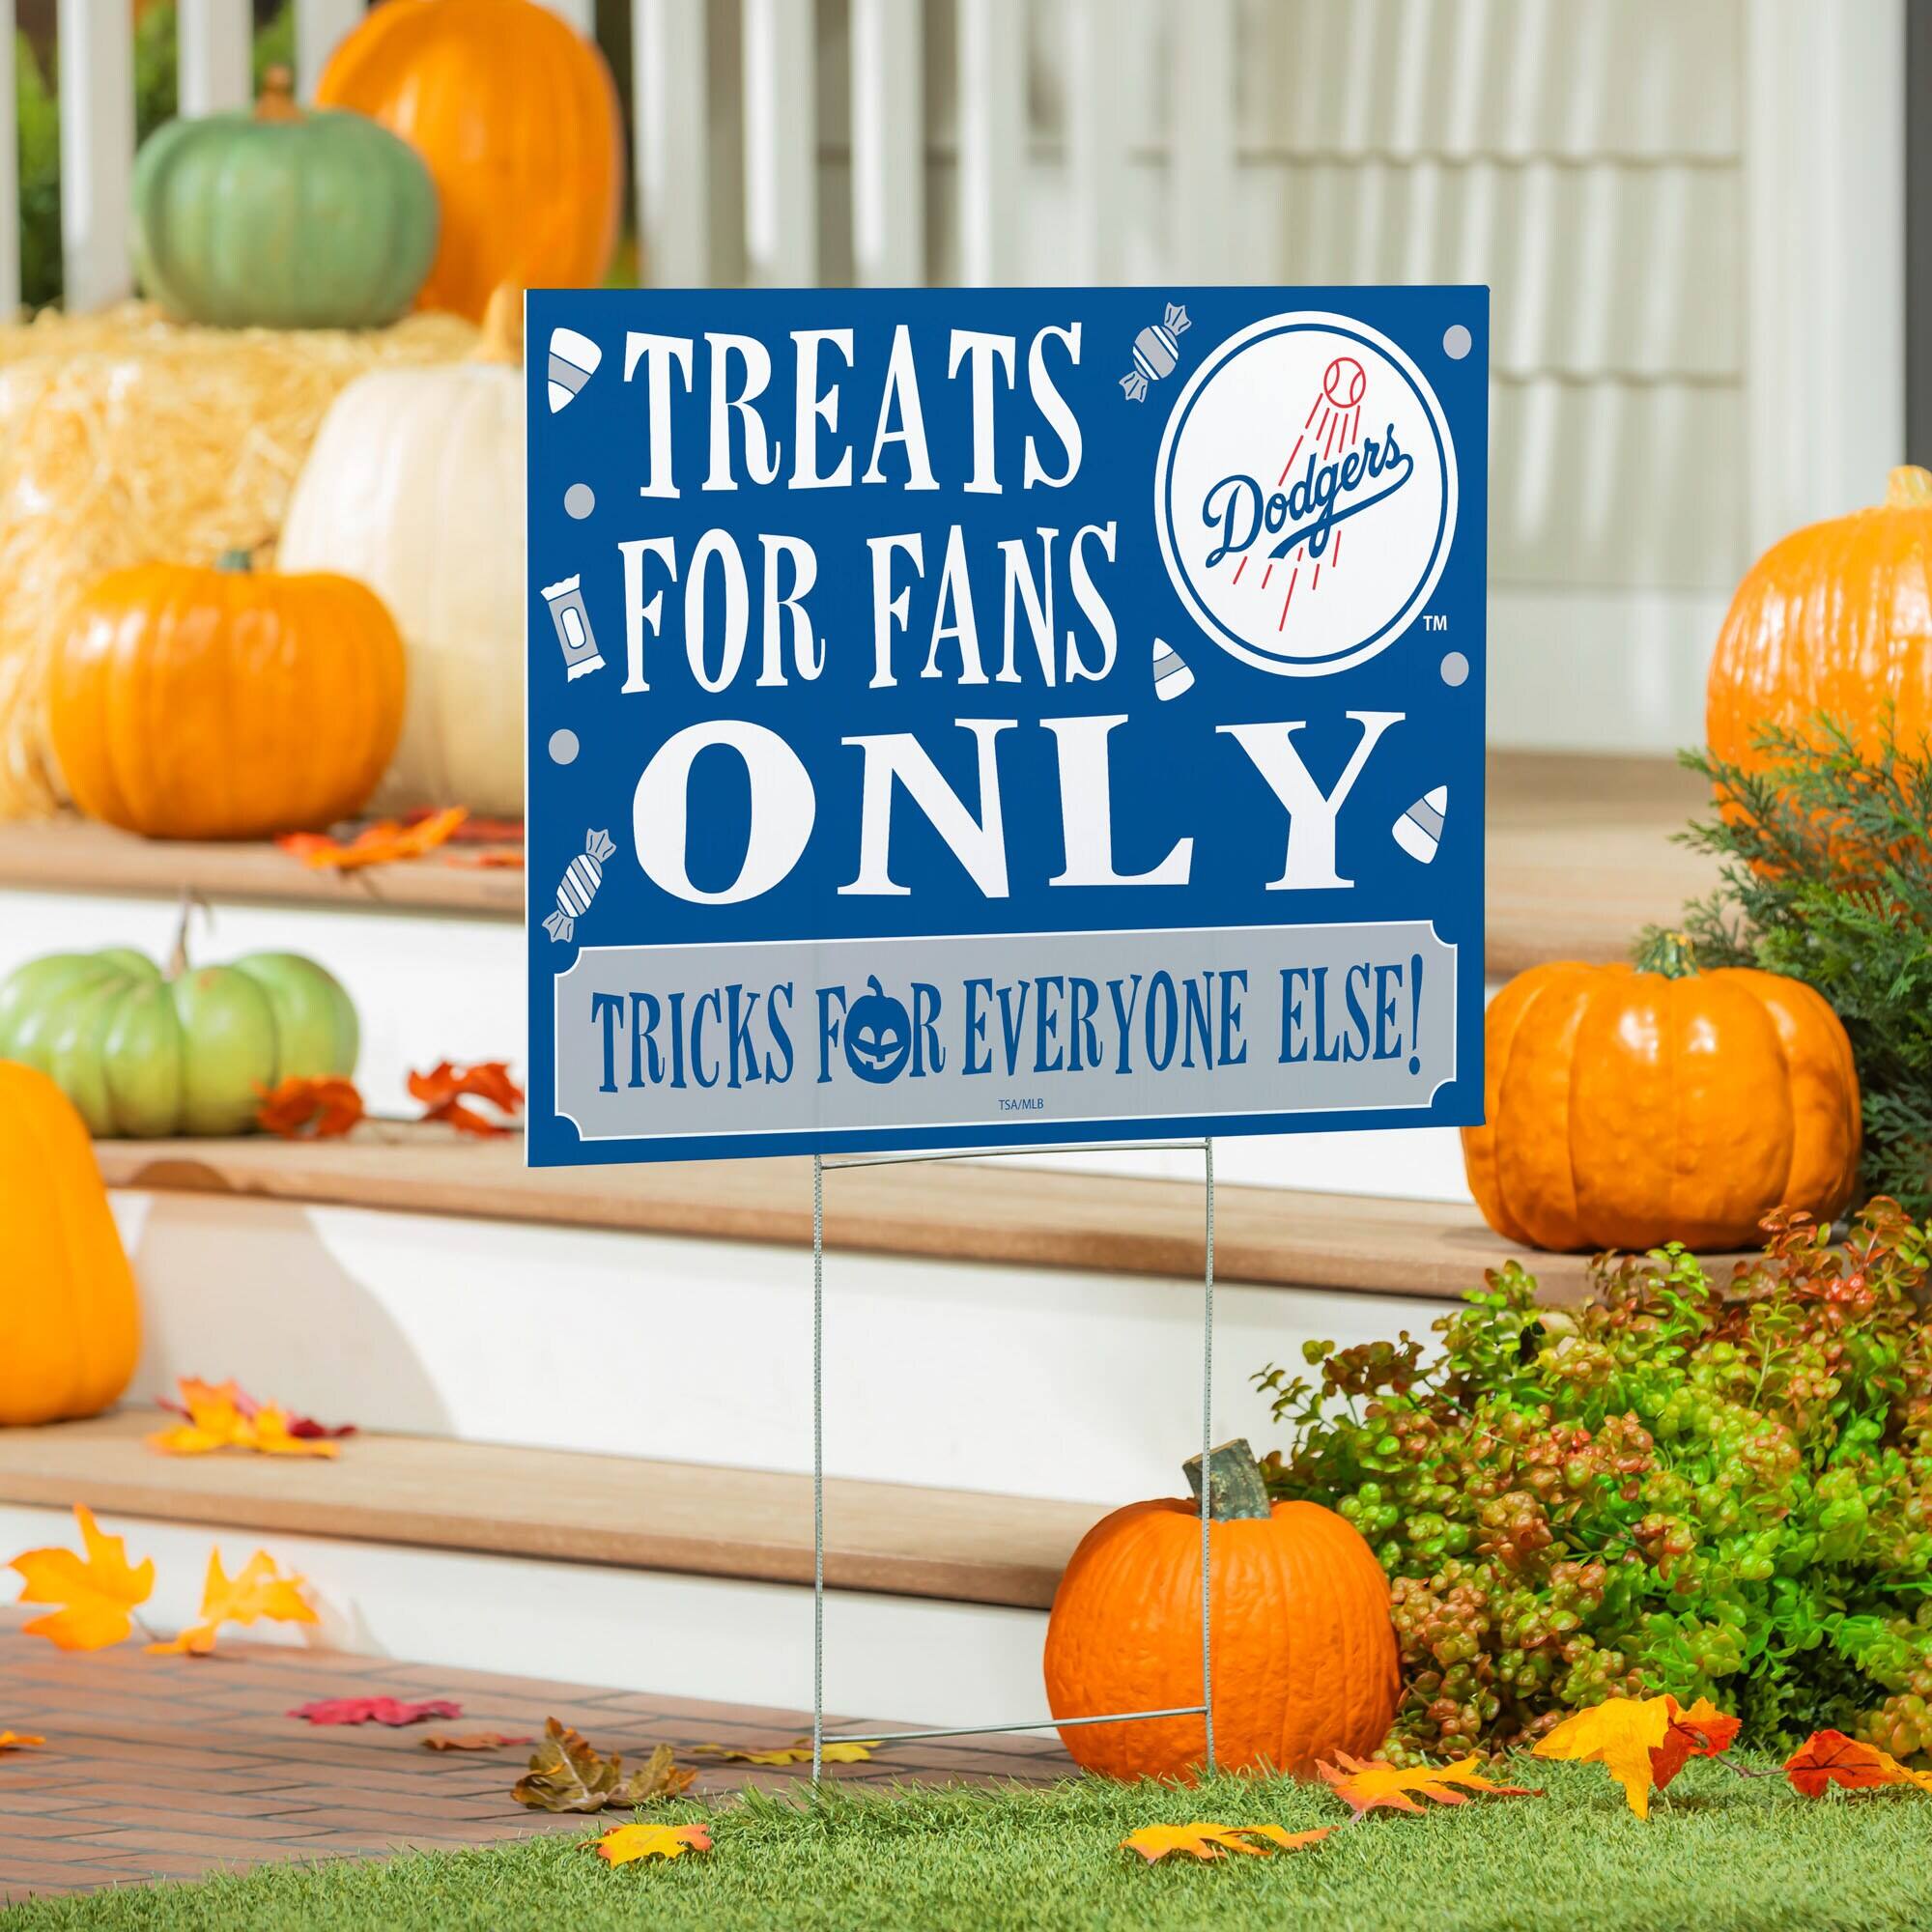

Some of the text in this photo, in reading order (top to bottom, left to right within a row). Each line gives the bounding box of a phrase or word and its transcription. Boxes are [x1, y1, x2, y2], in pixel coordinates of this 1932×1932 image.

[623, 322, 1083, 499] TREATS
[1202, 423, 1414, 569] Dodgers
[617, 521, 1118, 695] FOR FANS
[633, 710, 1406, 905] ONLY
[591, 983, 796, 1094] TRICKS
[961, 969, 1248, 1077] EVERYONE
[1278, 953, 1423, 1076] ELSE!
[998, 1097, 1044, 1111] TSA/MLB
